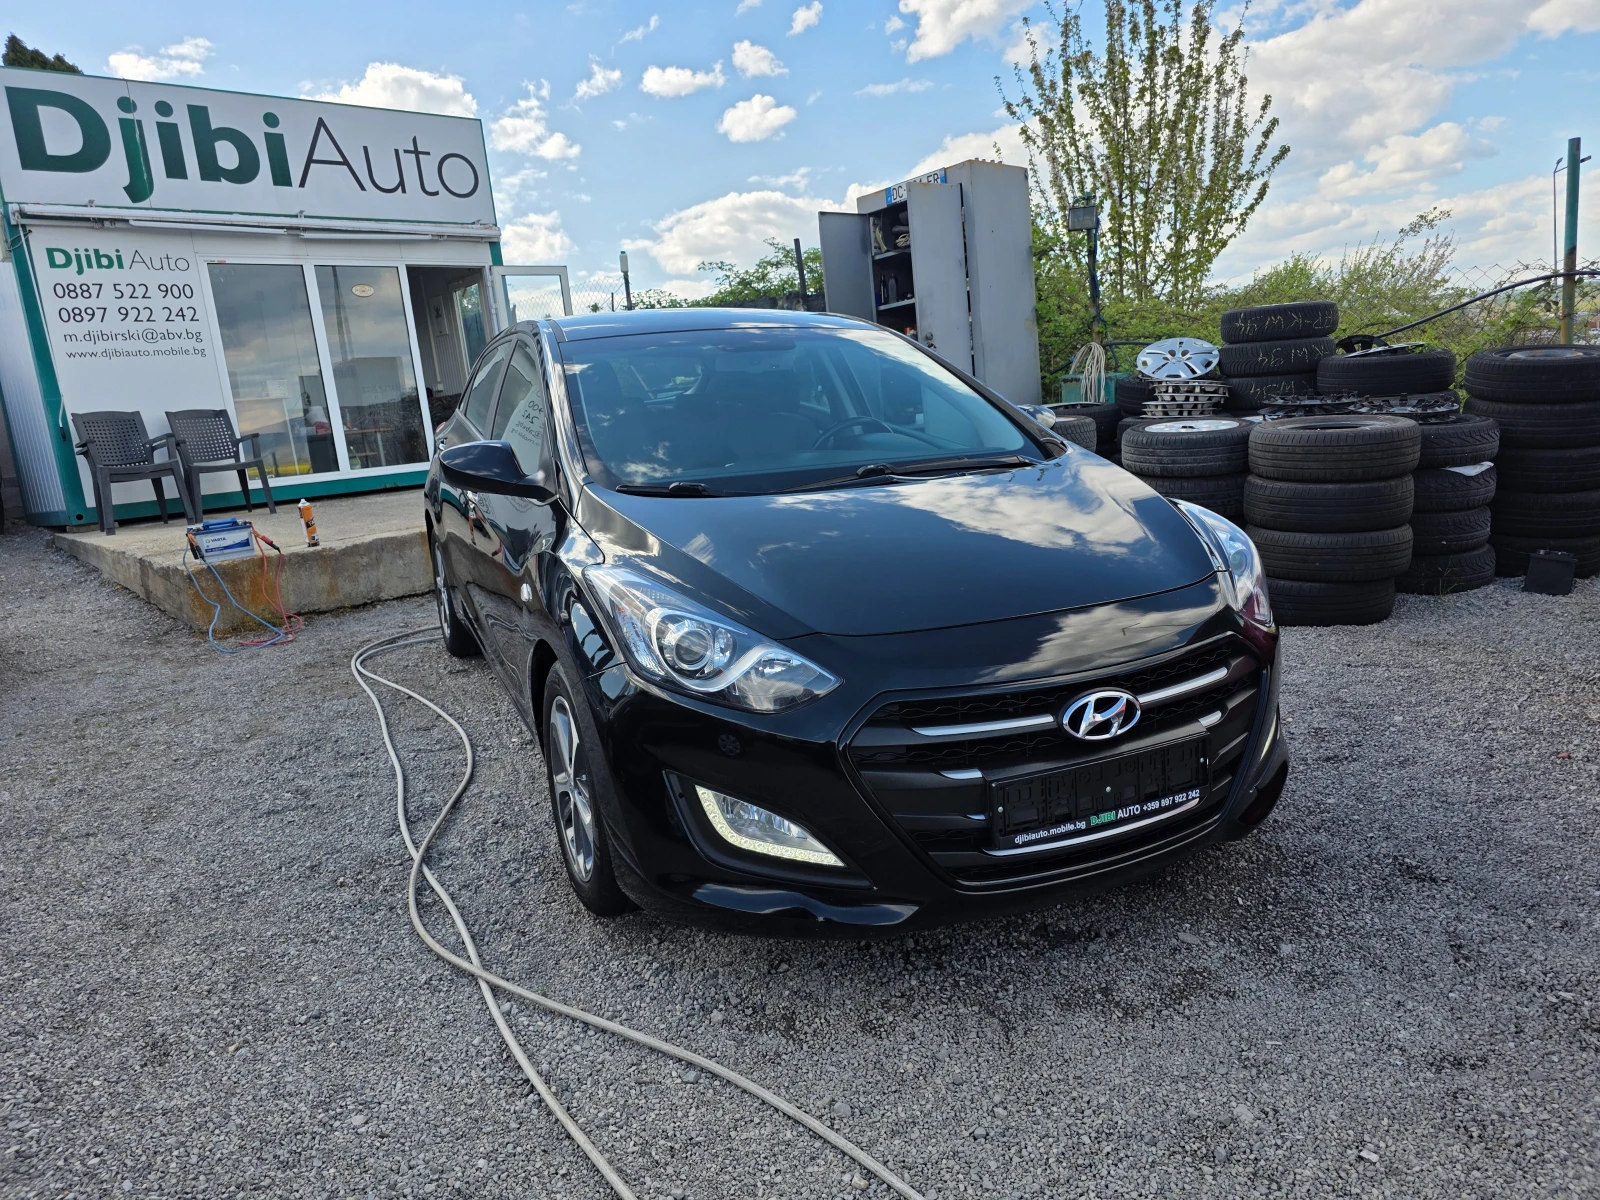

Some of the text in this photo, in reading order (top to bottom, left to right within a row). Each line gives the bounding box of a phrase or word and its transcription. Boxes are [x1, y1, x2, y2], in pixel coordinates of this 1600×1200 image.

[46, 248, 190, 275] Djibi Auto
[53, 283, 194, 299] 0887 522 900
[58, 306, 199, 323] 0897 922 242
[64, 328, 203, 345] m.djibirski@abv.bg
[66, 346, 207, 360] www.djibiauto.mobile.bg
[1014, 789, 1200, 844] djibiauto.mobile.bg DJIBI AUTO +359 897 922 242
